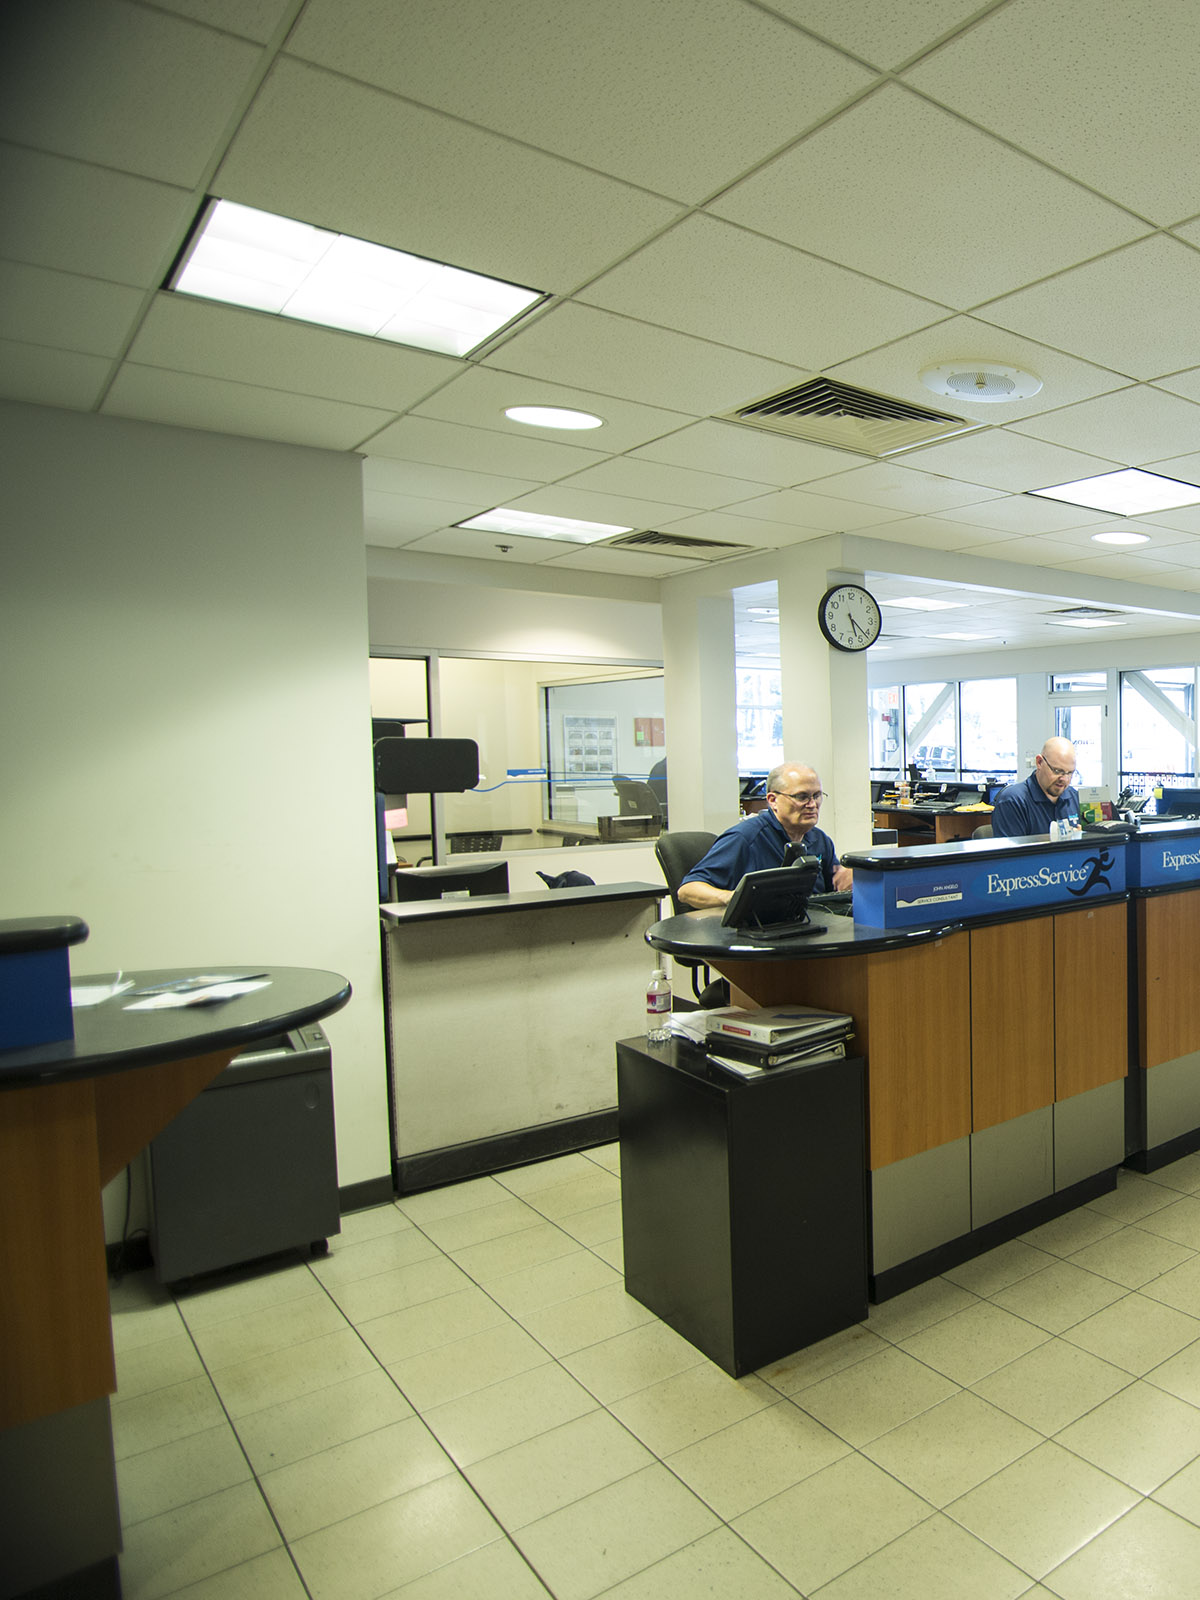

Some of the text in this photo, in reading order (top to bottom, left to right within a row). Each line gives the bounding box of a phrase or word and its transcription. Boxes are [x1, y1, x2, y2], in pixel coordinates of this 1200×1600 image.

[838, 594, 845, 602] 11
[848, 592, 855, 600] 12
[830, 601, 839, 609] 10
[865, 605, 871, 613] 2
[828, 611, 833, 619] 9
[867, 617, 874, 625] 3
[830, 623, 836, 632] 8
[839, 632, 844, 640] 7
[857, 635, 864, 643] 5
[847, 636, 854, 645] 6
[986, 863, 1087, 897] ExpressService
